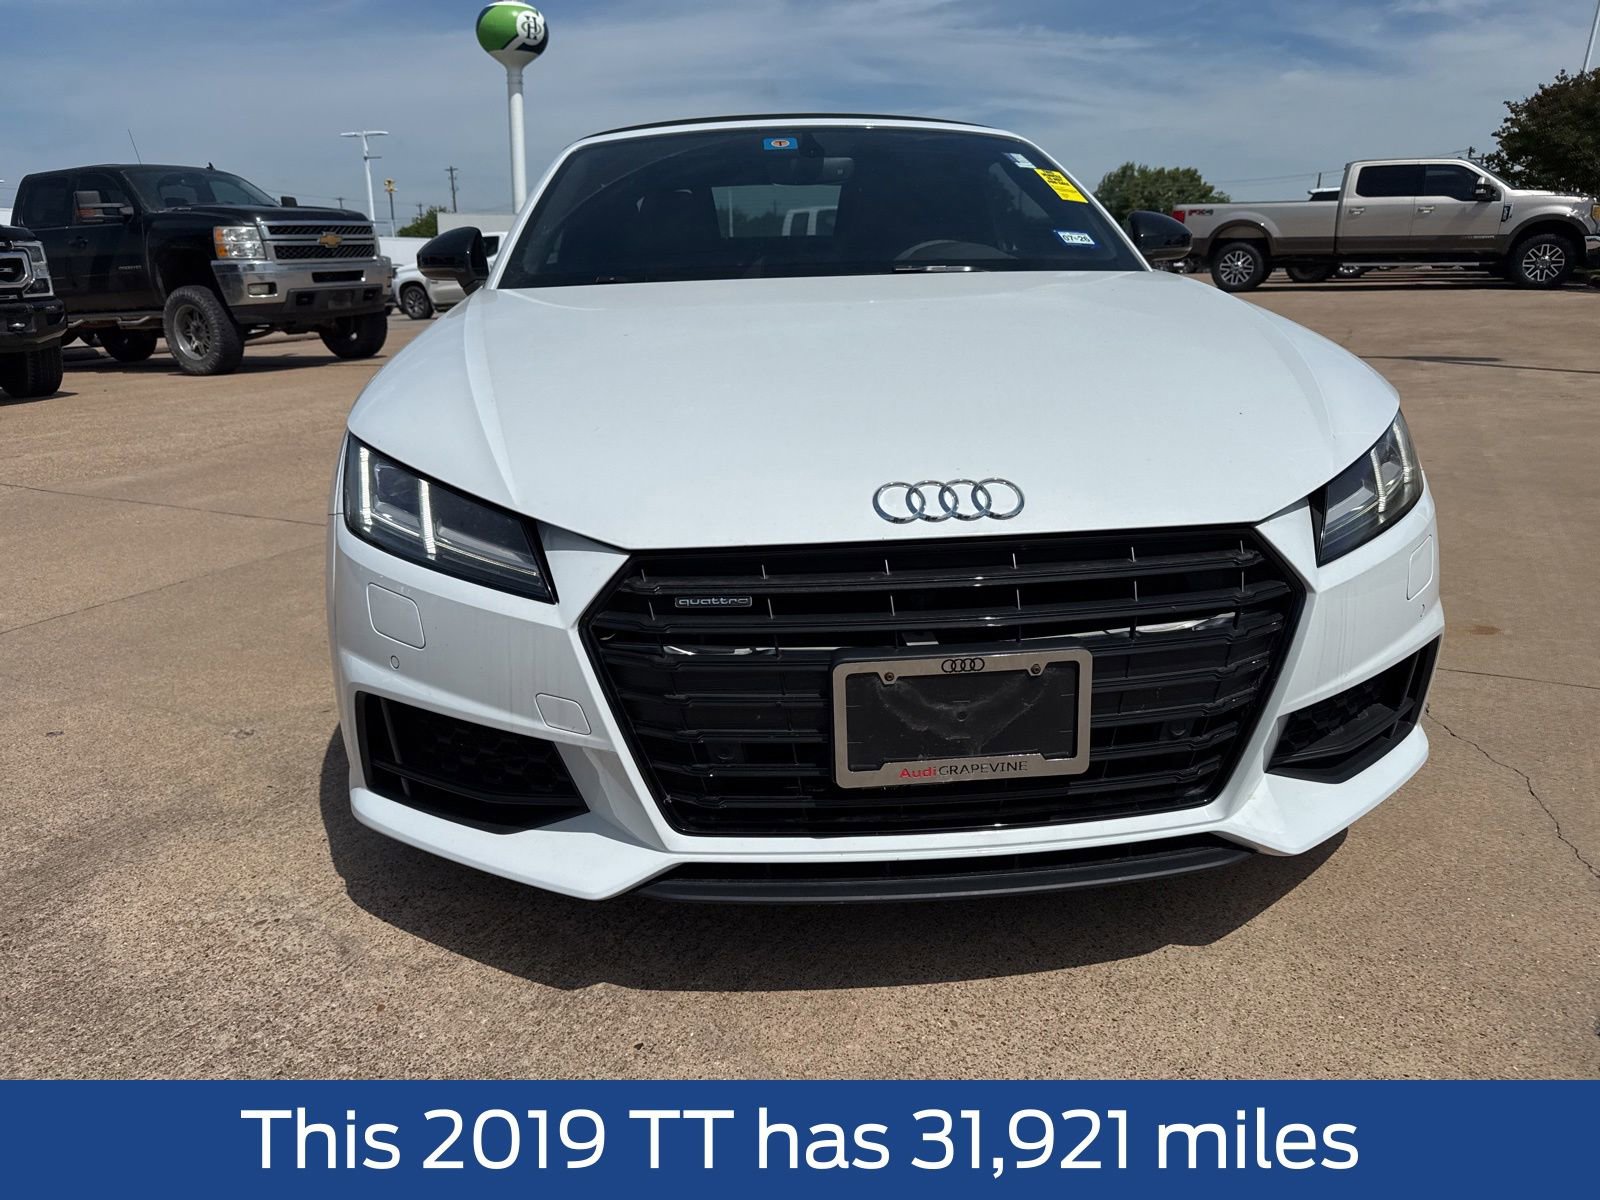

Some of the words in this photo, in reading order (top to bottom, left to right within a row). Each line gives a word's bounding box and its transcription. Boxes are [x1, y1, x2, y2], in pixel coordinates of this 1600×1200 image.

[678, 597, 749, 607] quattro
[899, 766, 937, 779] Audi
[938, 760, 1029, 776] GRAPEVINE
